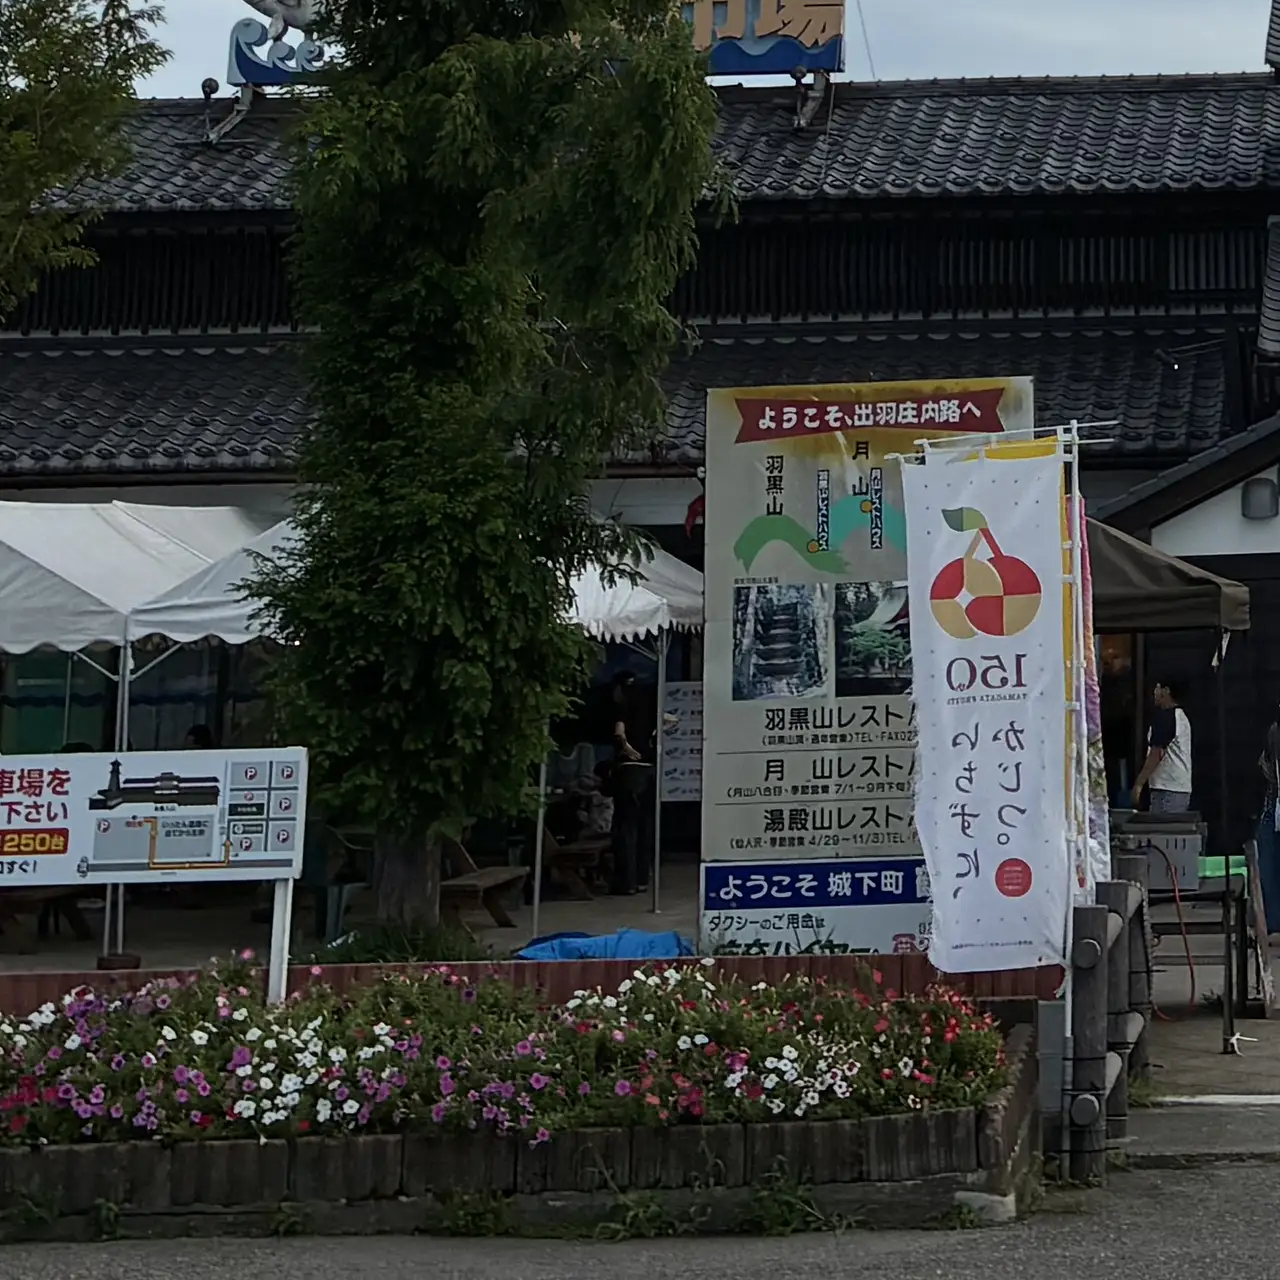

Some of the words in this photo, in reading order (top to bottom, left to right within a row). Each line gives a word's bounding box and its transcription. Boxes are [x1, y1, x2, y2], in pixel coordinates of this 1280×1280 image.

[758, 399, 982, 430] ようこそ、出羽庄内路へ
[765, 455, 785, 517] 羽黒山
[0, 801, 68, 825] 下さい
[719, 874, 819, 900] ようこそ
[827, 870, 904, 897] 城下町
[708, 913, 825, 932] タクシーのご用命は
